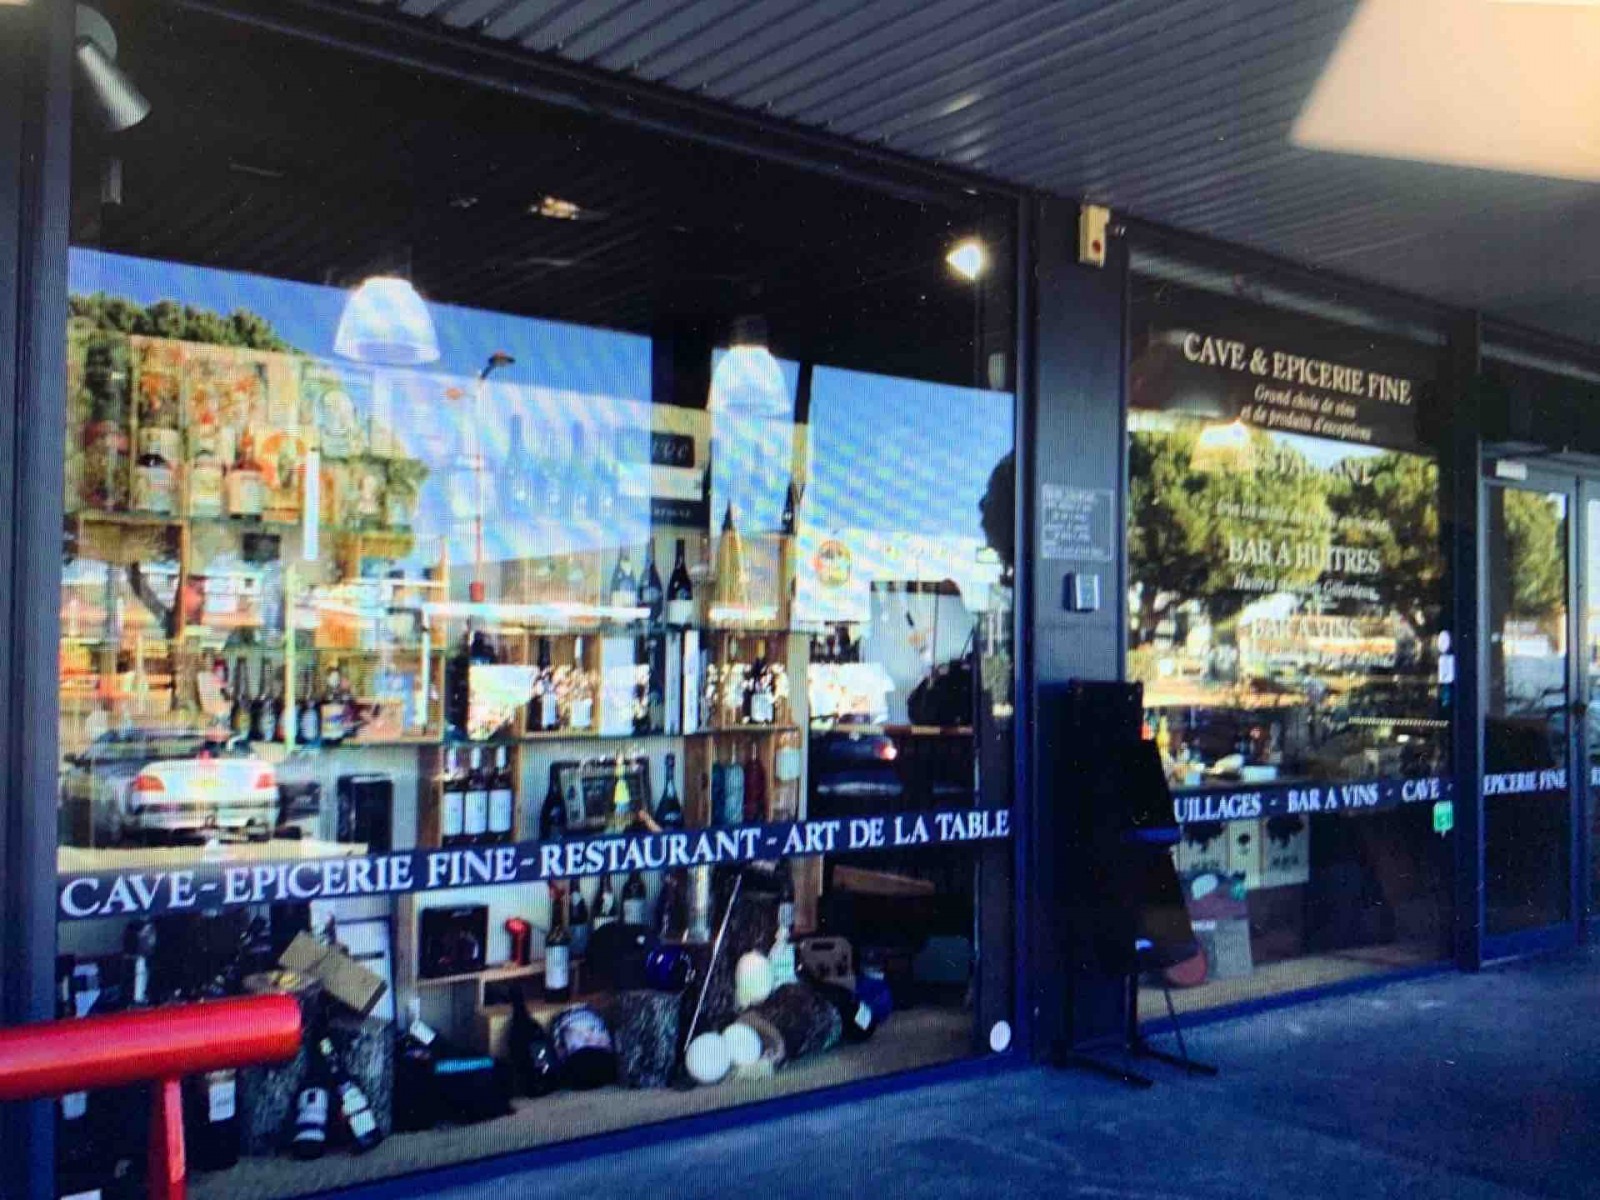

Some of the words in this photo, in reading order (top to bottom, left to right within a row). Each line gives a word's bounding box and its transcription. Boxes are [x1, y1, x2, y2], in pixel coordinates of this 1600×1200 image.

[1184, 332, 1246, 371] CAVE
[1250, 347, 1268, 376] &
[1273, 351, 1364, 395] EPICERIE
[1367, 372, 1412, 406] FINE
[1228, 538, 1273, 566] BAR
[1276, 540, 1291, 567] A
[1287, 788, 1320, 813] BAR
[1325, 787, 1338, 810] A
[1342, 783, 1379, 807] VINS
[1402, 777, 1441, 802] CAVE
[849, 816, 885, 849] DE
[893, 815, 930, 846] LA
[934, 809, 1011, 841] TABLE
